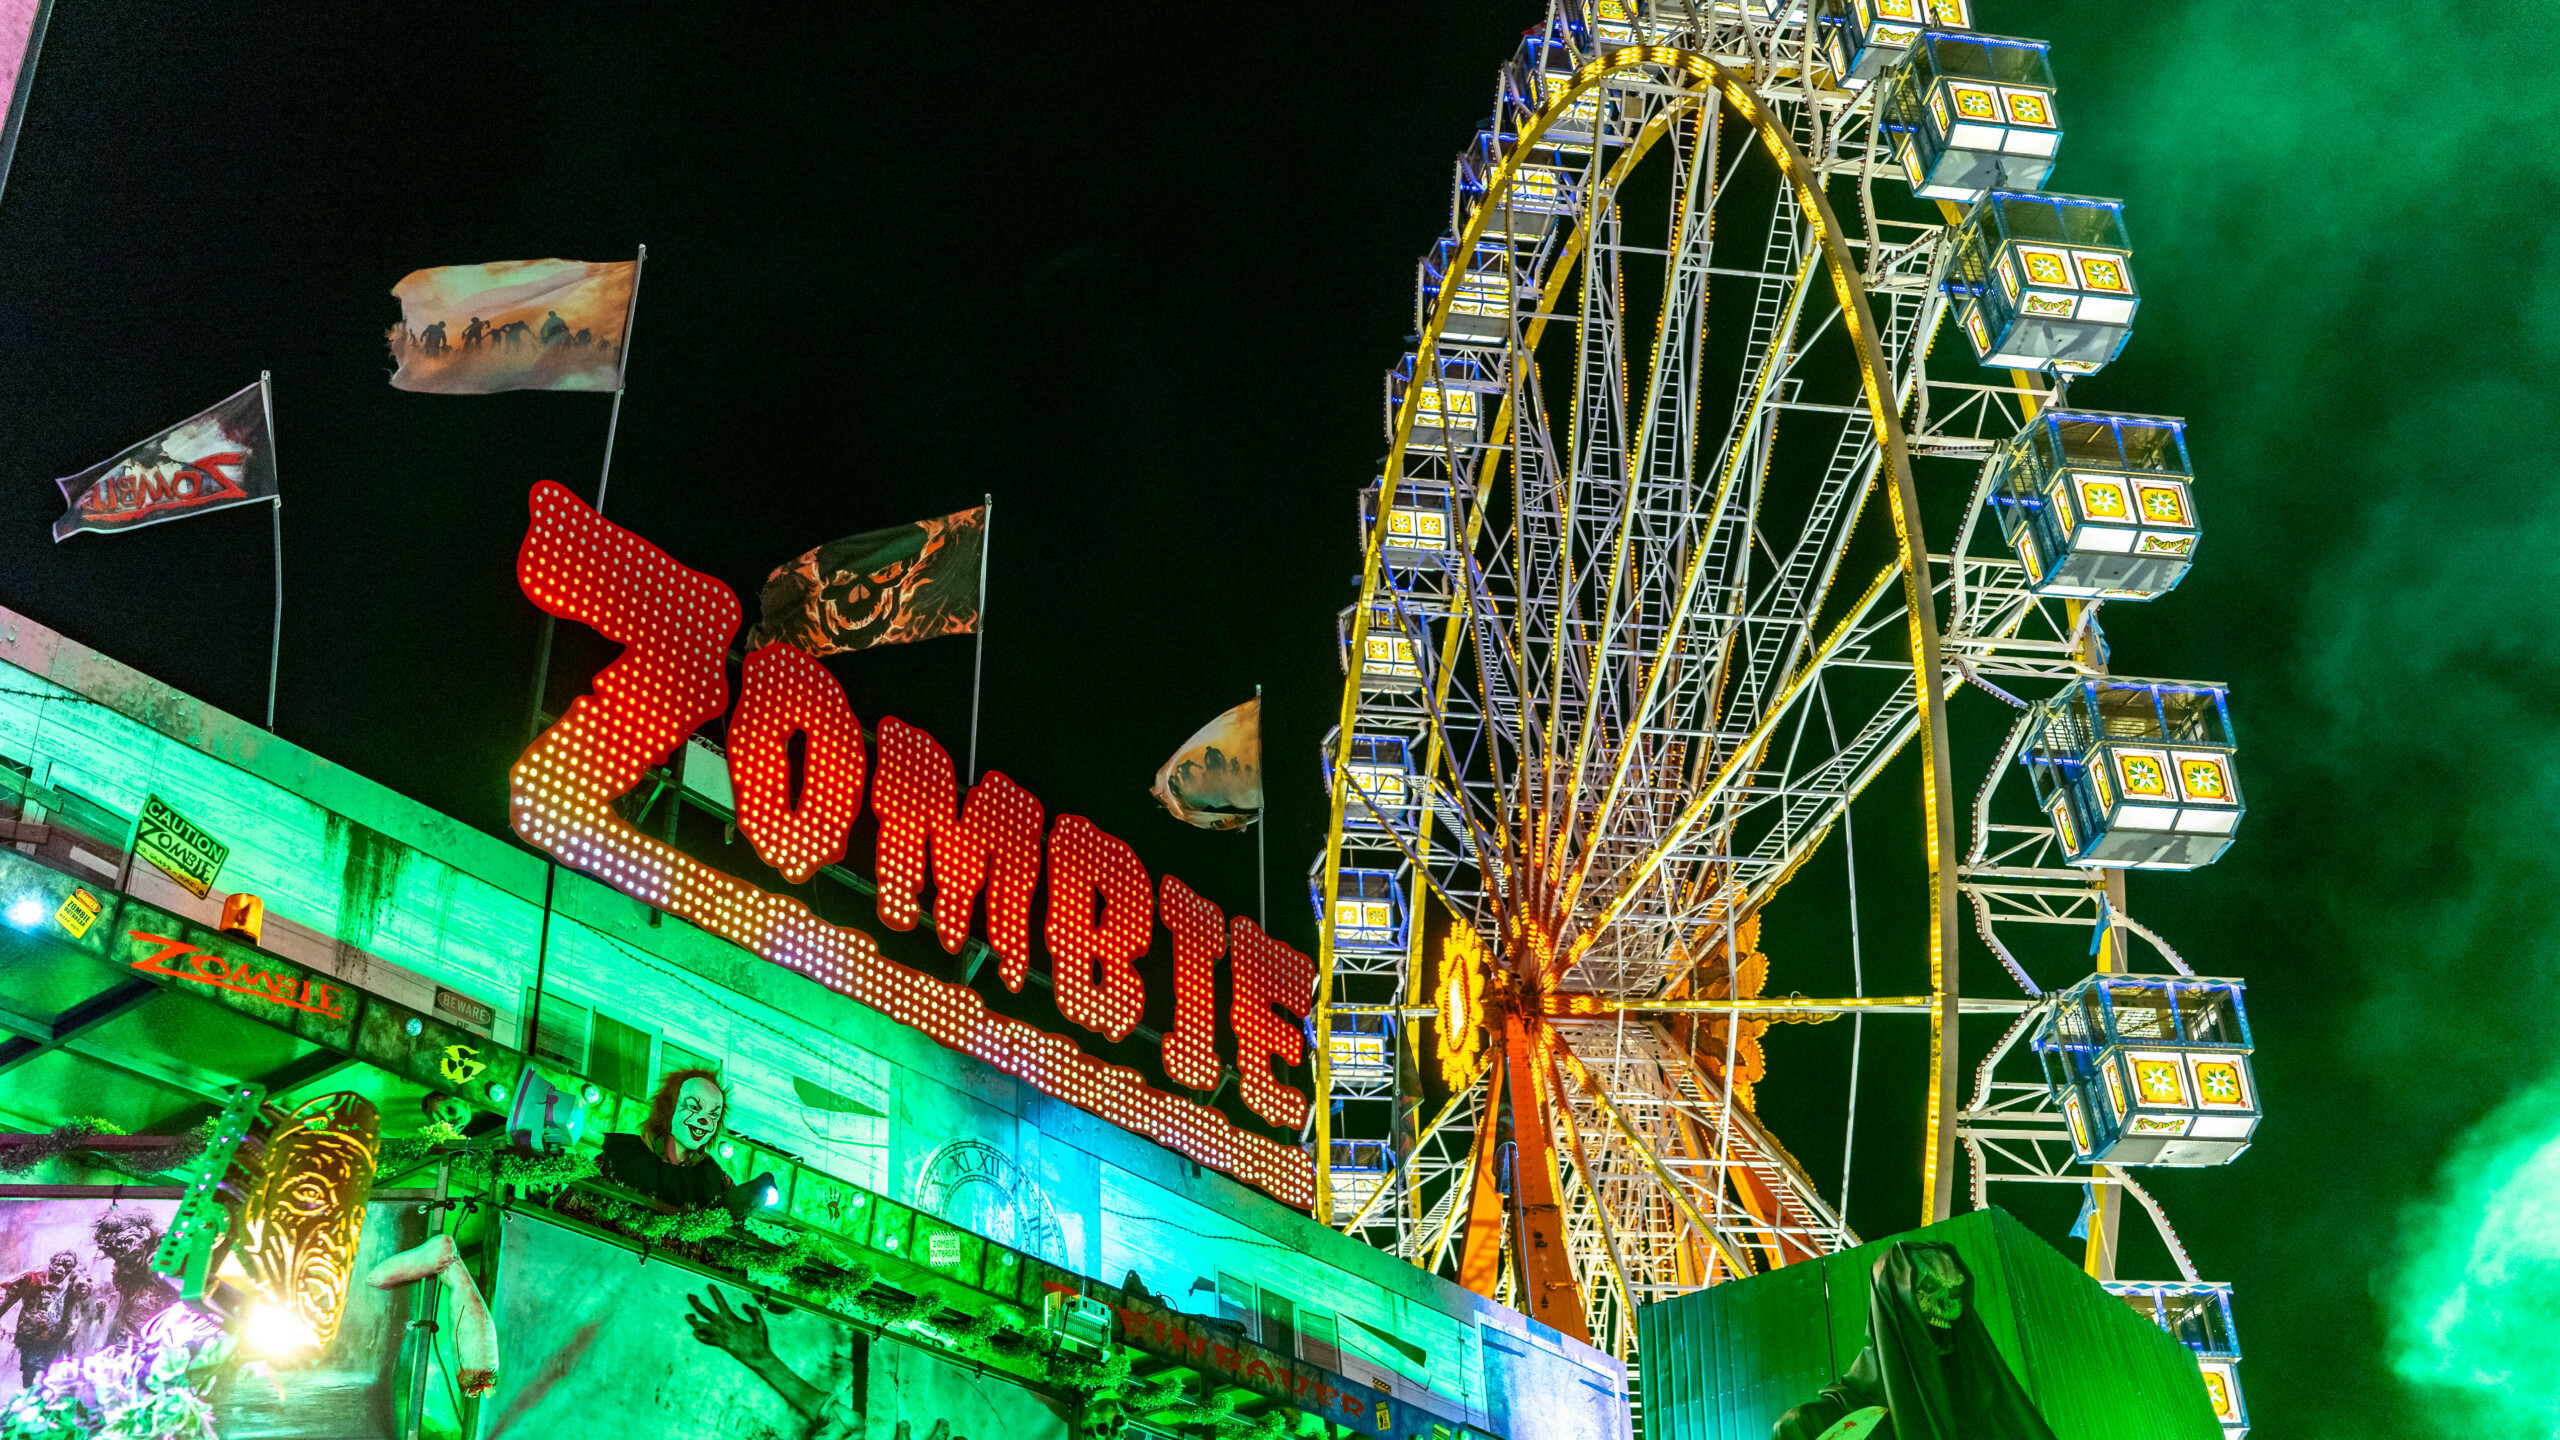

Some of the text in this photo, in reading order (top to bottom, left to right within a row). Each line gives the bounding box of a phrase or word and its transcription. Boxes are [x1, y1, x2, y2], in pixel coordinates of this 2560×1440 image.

[148, 801, 223, 863] CAUTION
[510, 480, 1317, 1212] ZOMBIE
[136, 816, 215, 885] ZOMBIE
[67, 900, 91, 922] ZOMBIE
[77, 890, 99, 910] DANGER
[64, 907, 86, 927] OUTBREAK
[128, 929, 343, 1018] ZOMBIE
[443, 993, 487, 1022] BEWARE
[977, 1149, 1001, 1179] XII
[930, 1249, 960, 1258] OUTBREAK
[932, 1239, 957, 1249] ZOMBIE
[1043, 1281, 1365, 1419] EINBAUER
